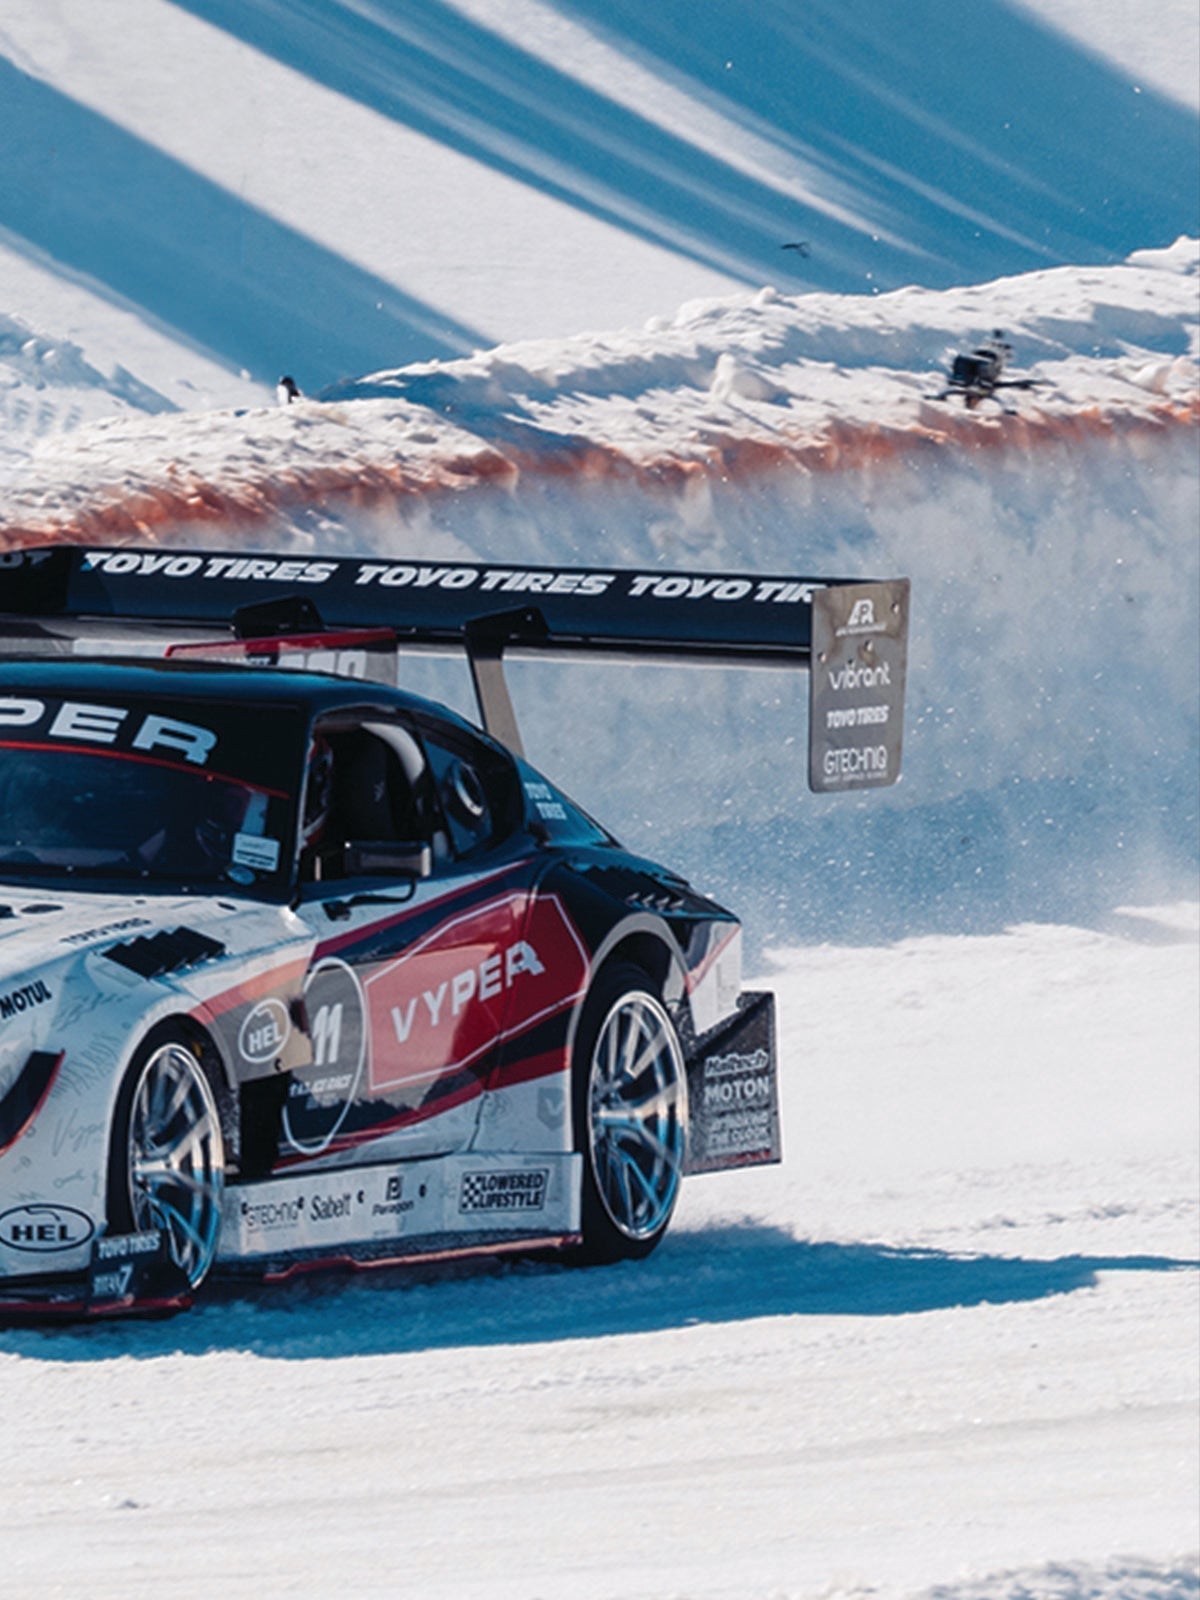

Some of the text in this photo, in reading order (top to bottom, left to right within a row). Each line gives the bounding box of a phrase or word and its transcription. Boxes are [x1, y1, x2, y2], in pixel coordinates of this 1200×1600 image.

[81, 552, 205, 576] TOYO
[204, 556, 340, 582] TIRES
[354, 564, 619, 596] TOYO TIRES
[628, 576, 827, 604] TOYO TIR
[826, 705, 890, 729] TOYO TIRES
[390, 940, 546, 1044] VYPER
[248, 1022, 284, 1054] HEL
[312, 1003, 343, 1066] 11
[704, 1076, 770, 1104] MOTON
[11, 1223, 77, 1242] HEL
